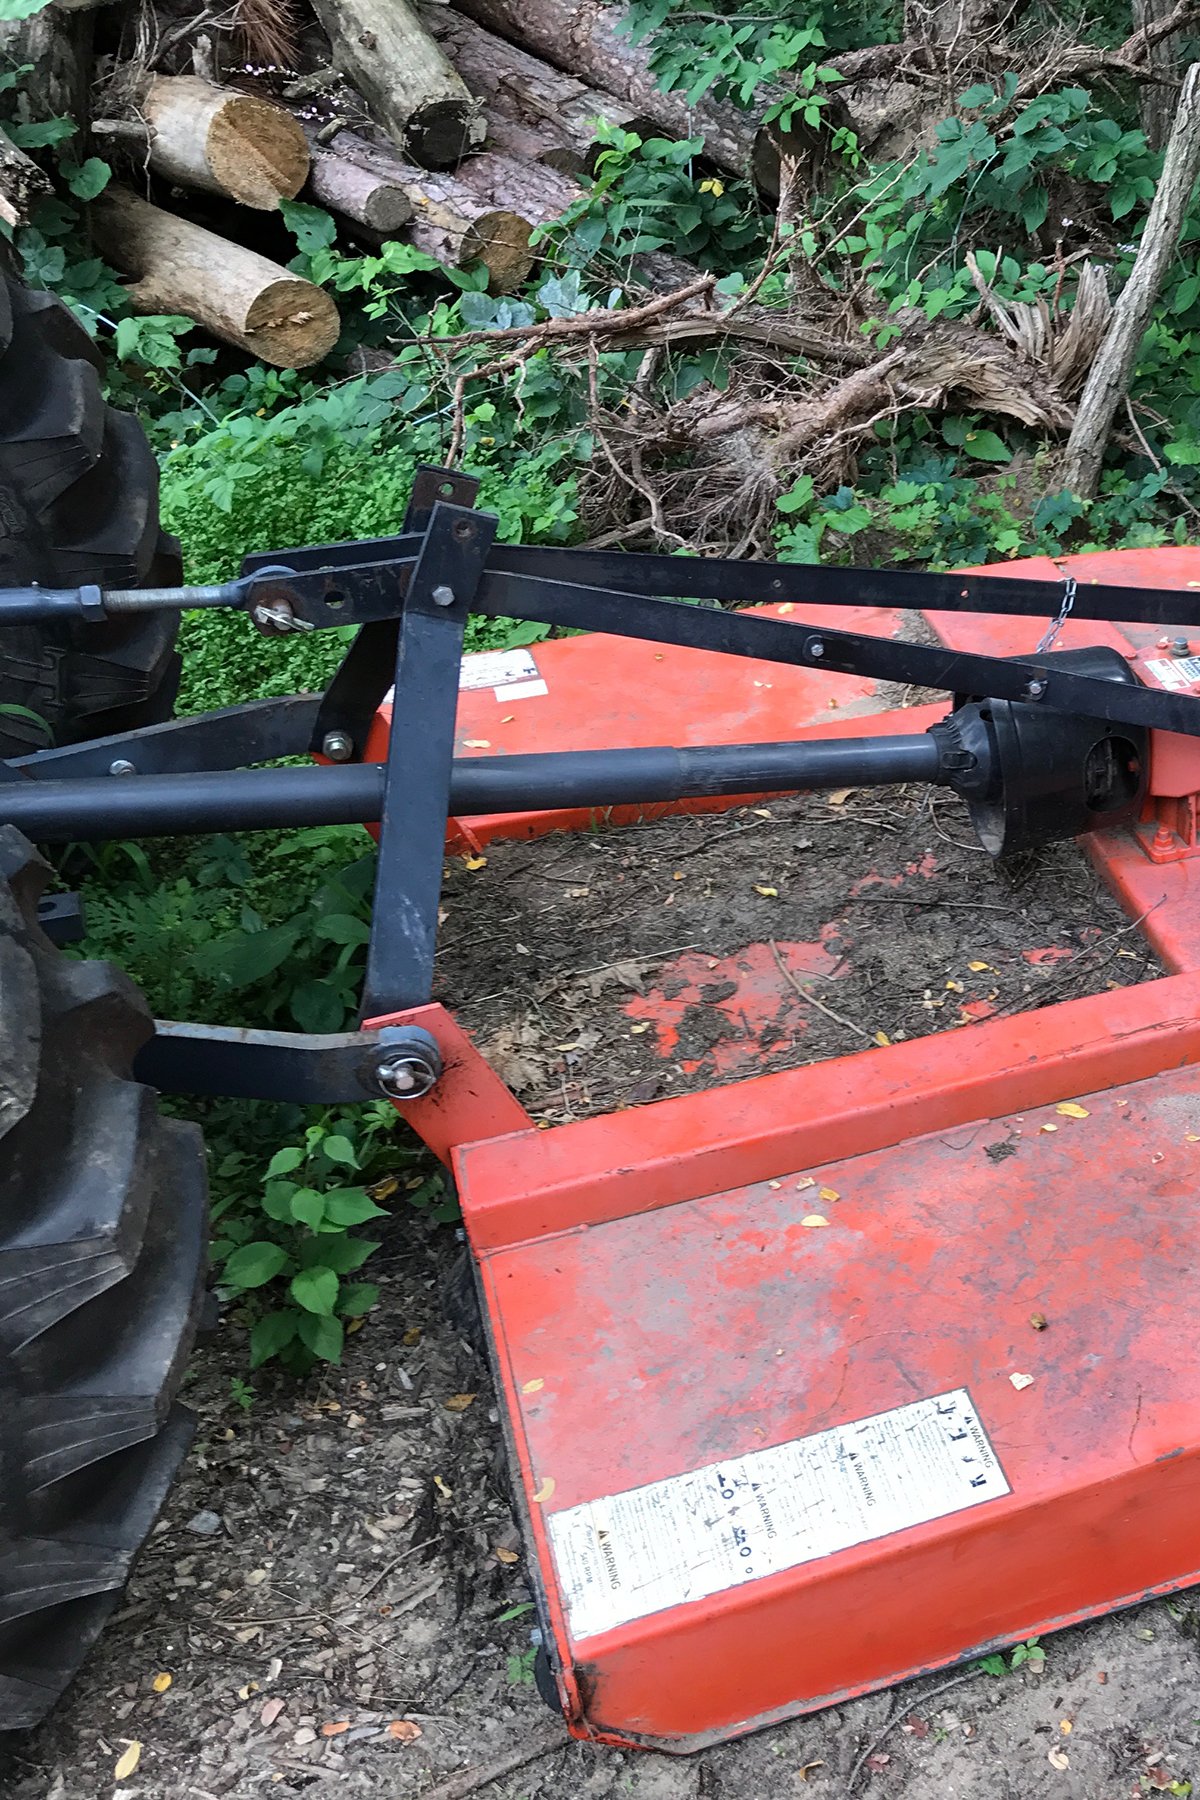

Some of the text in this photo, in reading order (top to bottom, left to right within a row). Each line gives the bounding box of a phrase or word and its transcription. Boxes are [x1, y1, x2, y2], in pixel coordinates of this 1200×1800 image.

[970, 1426, 994, 1468] WARNING
[854, 1462, 877, 1507] WARNING
[755, 1493, 777, 1539] WARNING
[602, 1541, 622, 1590] WARNING
